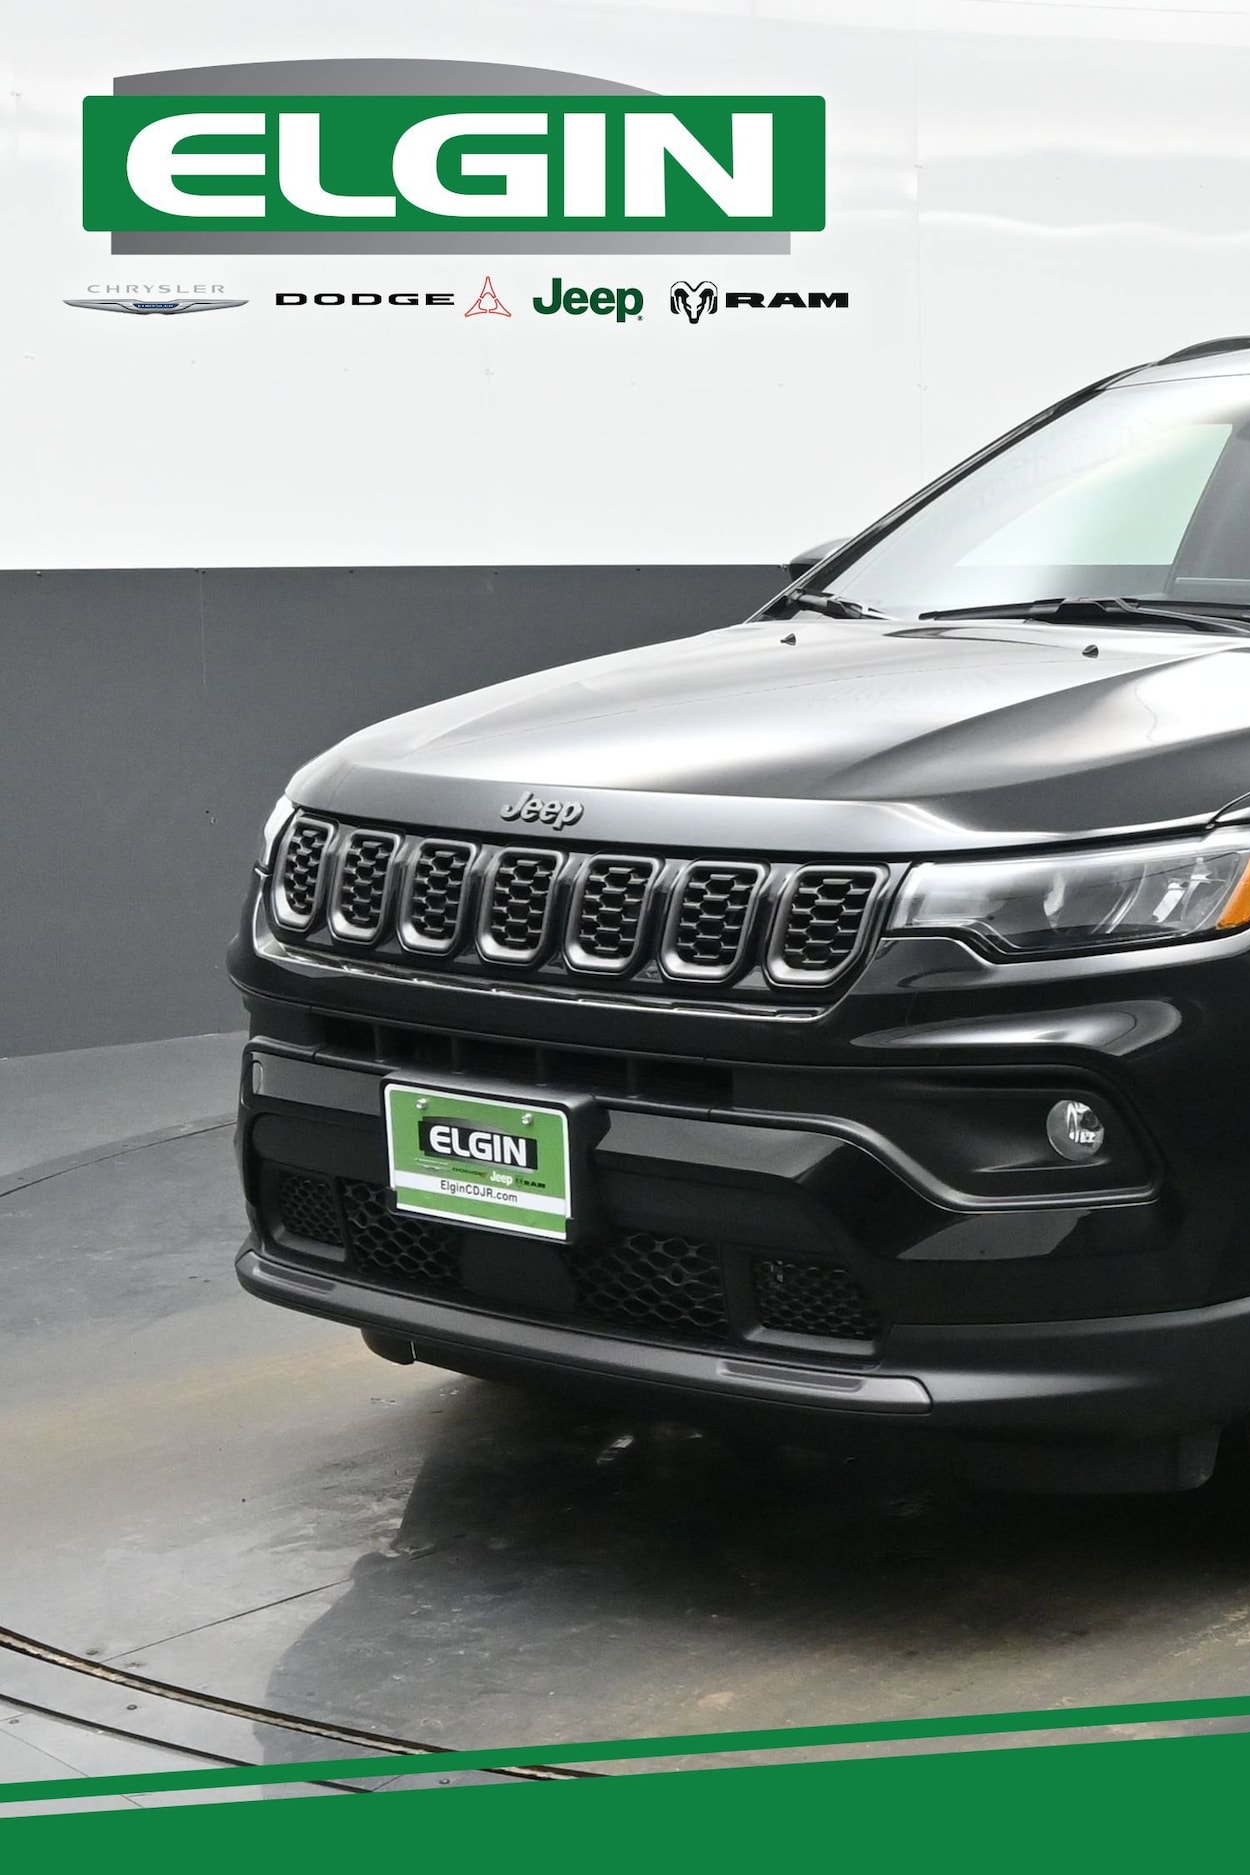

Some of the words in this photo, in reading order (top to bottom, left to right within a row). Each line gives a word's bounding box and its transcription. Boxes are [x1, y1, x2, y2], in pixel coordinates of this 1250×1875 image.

[500, 791, 584, 831] Jeep
[429, 1125, 526, 1167] ELGIN
[440, 1180, 518, 1203] ElginCDJR.com
